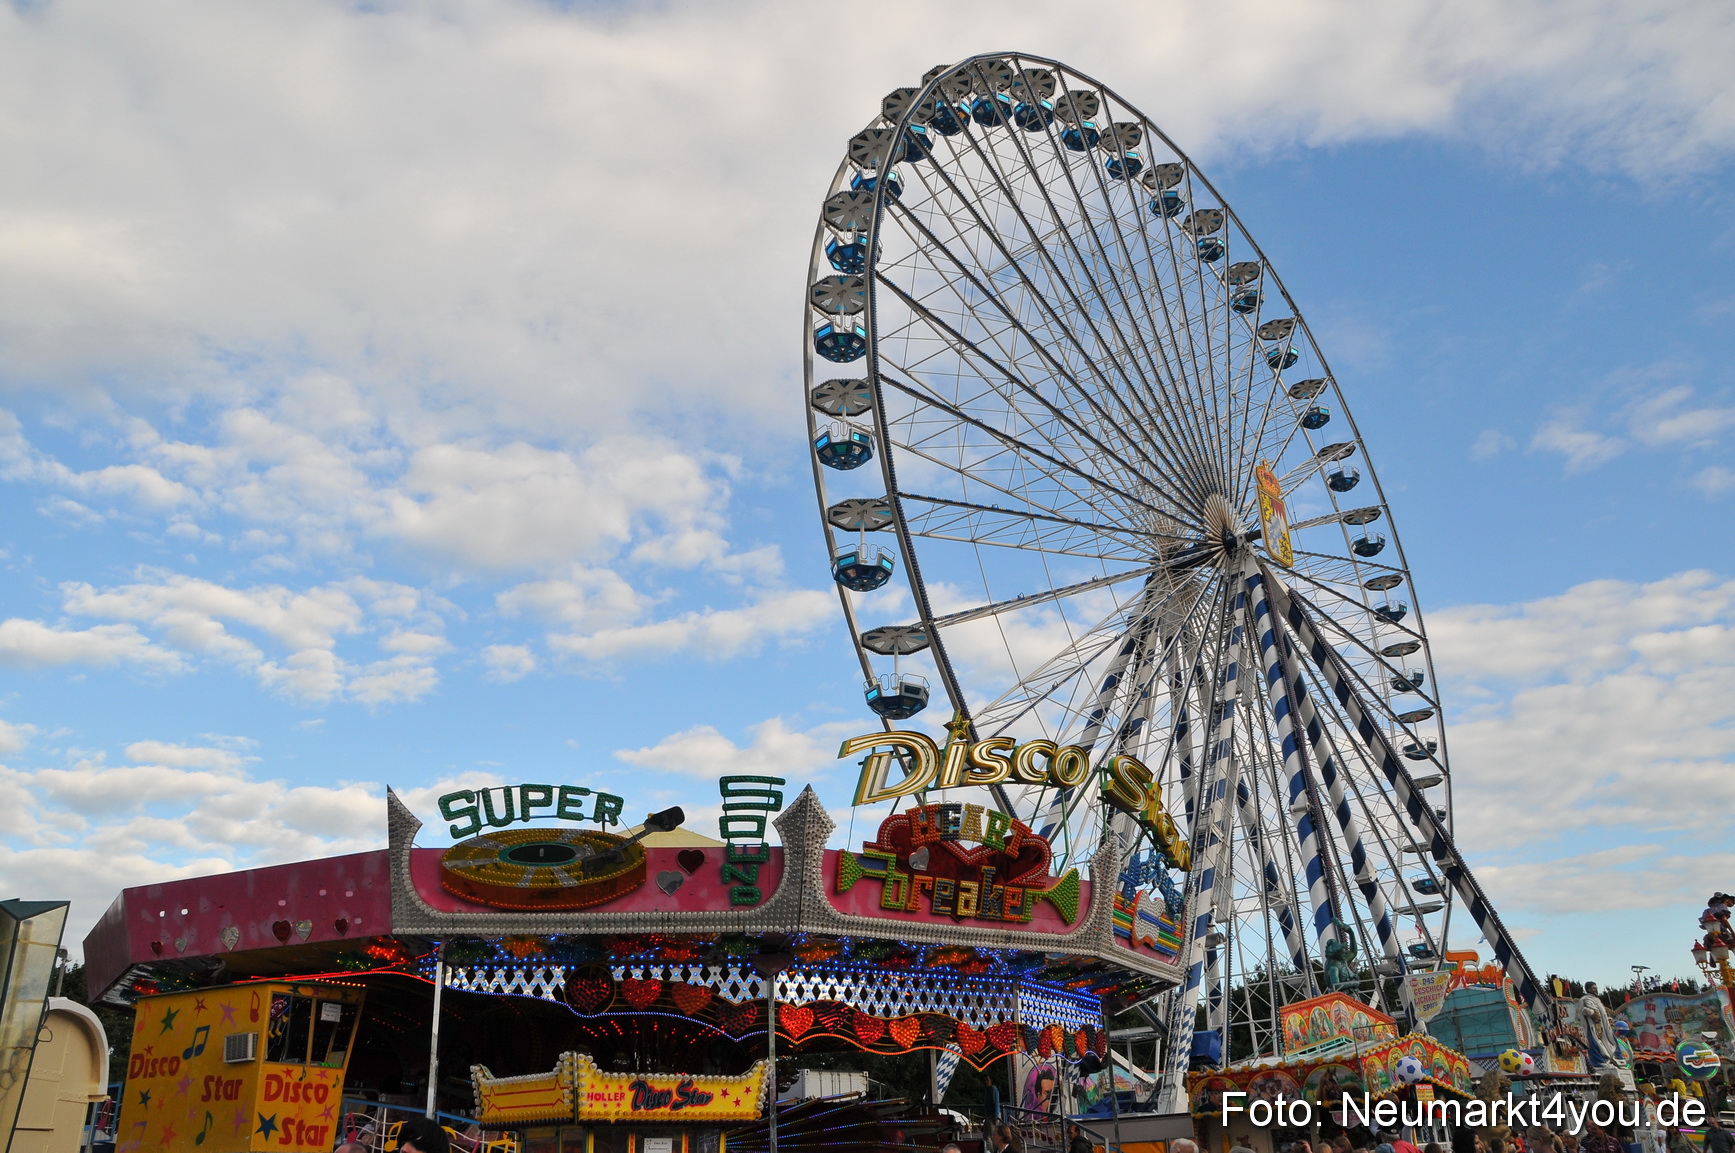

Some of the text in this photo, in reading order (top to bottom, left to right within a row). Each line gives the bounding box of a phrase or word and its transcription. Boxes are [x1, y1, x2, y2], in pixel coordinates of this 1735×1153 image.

[838, 731, 1089, 807] Disco
[438, 784, 625, 839] SUPER
[905, 802, 1034, 859] HEART
[862, 850, 1050, 923] breaker
[1422, 976, 1435, 985] DAS
[128, 1053, 181, 1080] Disco
[201, 1074, 243, 1102] Star
[263, 1073, 329, 1105] Disco
[628, 1079, 673, 1112] Disco
[669, 1079, 714, 1112] Star
[278, 1116, 329, 1147] Star
